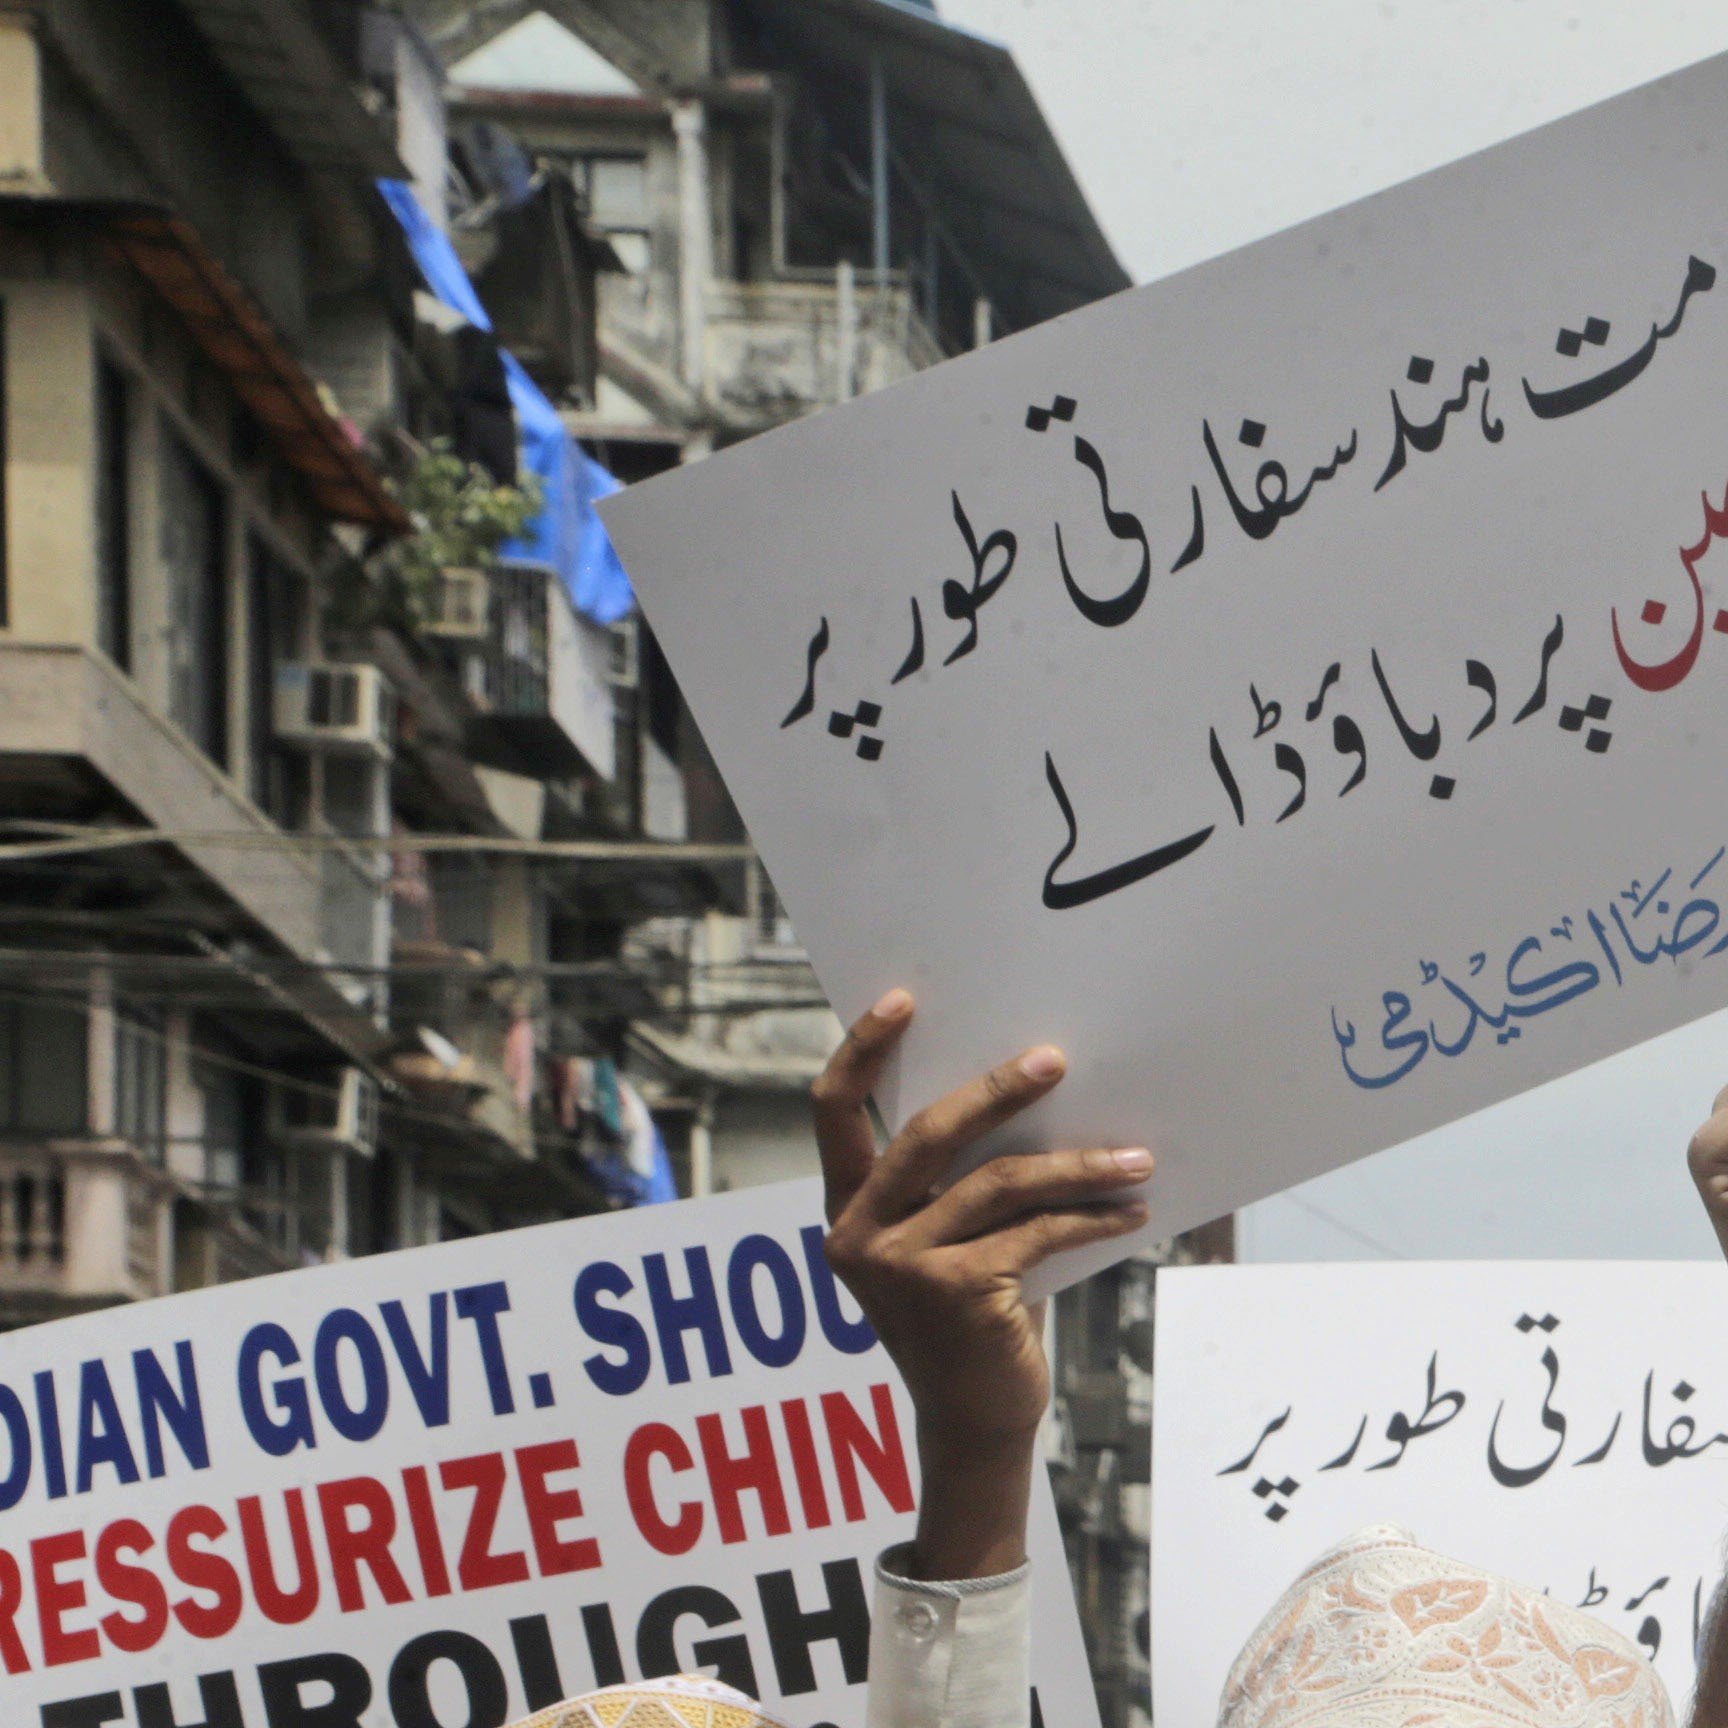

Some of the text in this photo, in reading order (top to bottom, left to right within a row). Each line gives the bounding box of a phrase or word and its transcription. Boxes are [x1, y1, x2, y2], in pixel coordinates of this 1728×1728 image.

[1375, 355, 1504, 490] ہند
[891, 489, 1017, 683] طور
[1024, 395, 1357, 628] سفارتی
[780, 616, 883, 762] پر
[1306, 647, 1497, 799] دباؤ
[1512, 614, 1612, 753] پر
[1042, 682, 1306, 910] ڈالے
[237, 1281, 551, 1457] GOVT.
[1317, 1350, 1466, 1472] طور
[1216, 1404, 1302, 1522] پر
